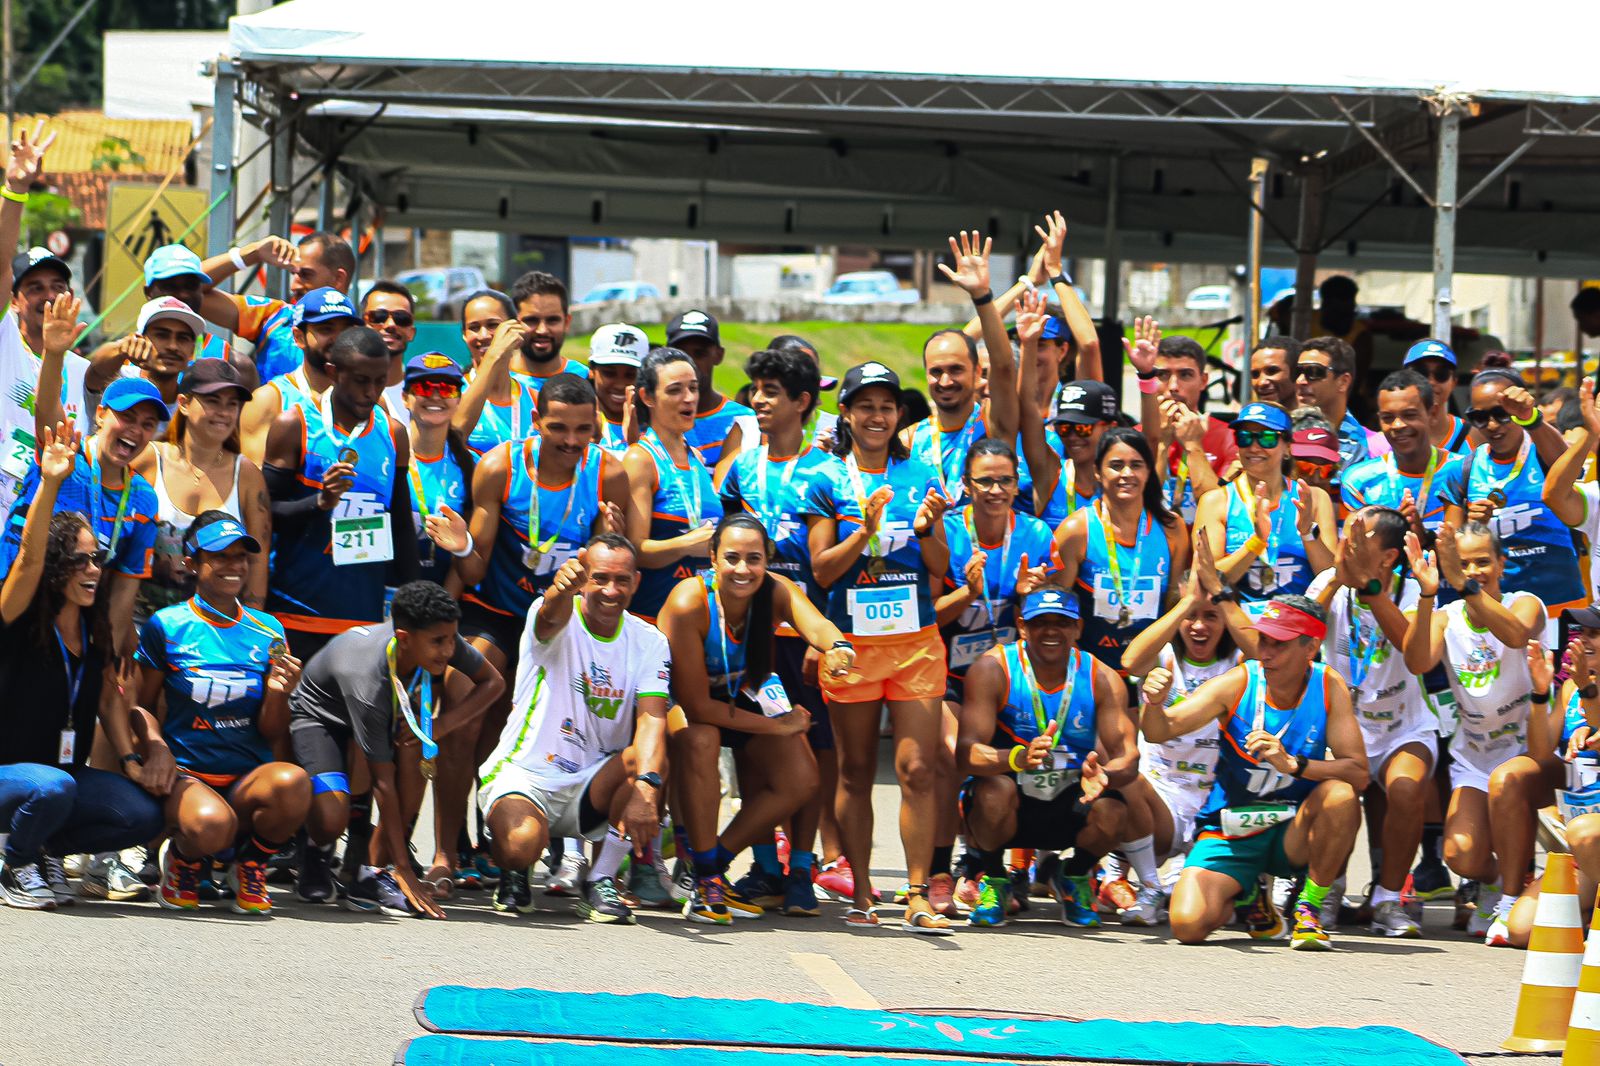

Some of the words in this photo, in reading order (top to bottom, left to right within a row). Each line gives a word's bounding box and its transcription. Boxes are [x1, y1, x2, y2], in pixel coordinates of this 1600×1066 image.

[342, 531, 375, 548] 211
[879, 572, 919, 581] AVANTE
[1108, 591, 1144, 606] 024
[865, 602, 904, 620] 005
[1240, 812, 1280, 828] 243
